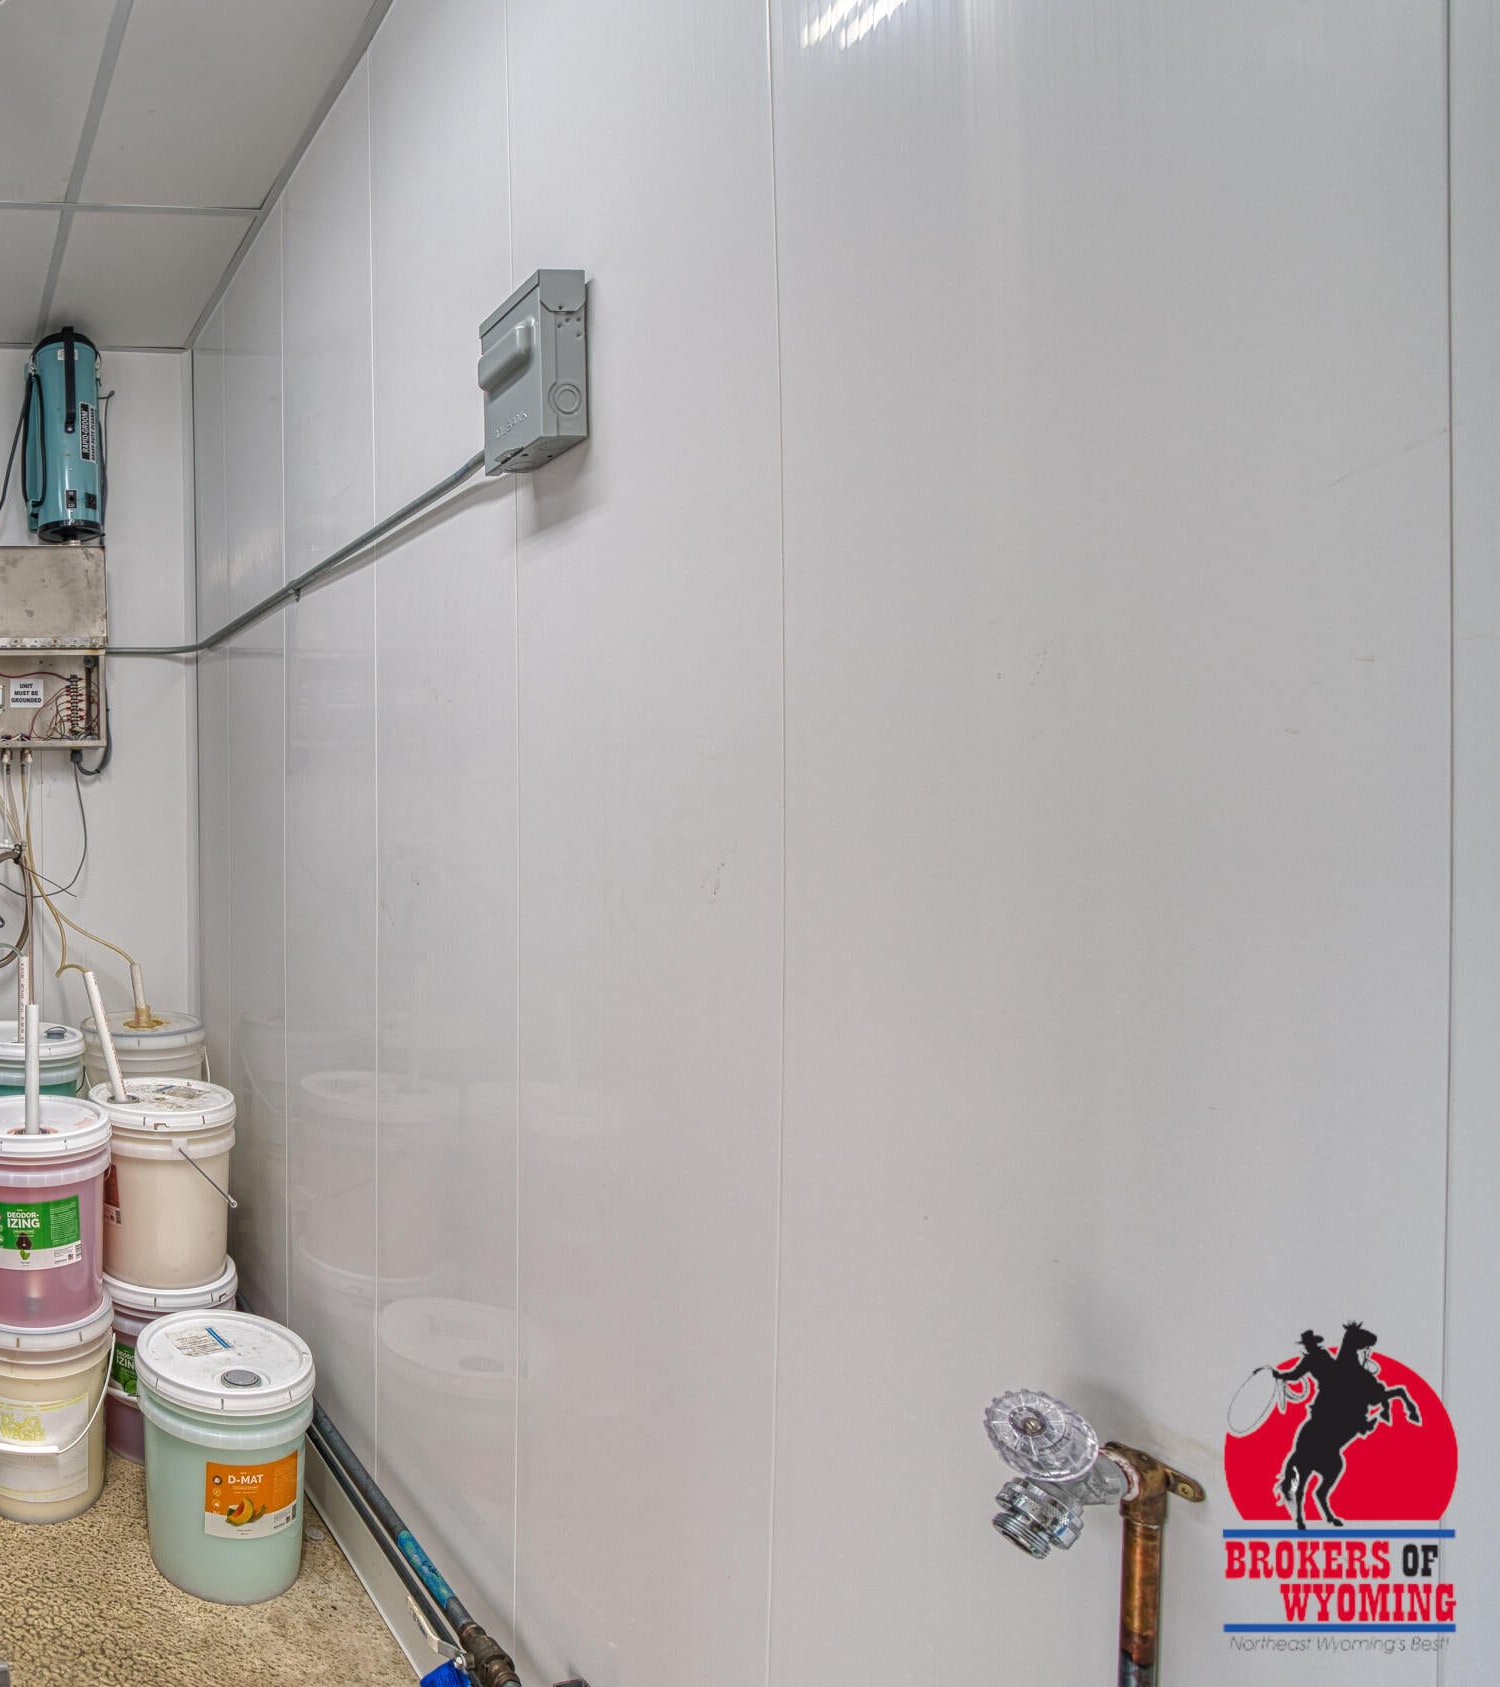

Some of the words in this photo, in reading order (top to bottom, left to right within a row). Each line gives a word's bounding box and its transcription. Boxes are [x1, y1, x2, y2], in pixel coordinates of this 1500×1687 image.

[81, 410, 89, 453] RAPID-GROOM
[6, 1211, 40, 1219] DEODOR-
[7, 1218, 40, 1228] IZING
[116, 1354, 135, 1370] IZIN
[227, 1474, 264, 1485] D-MAT
